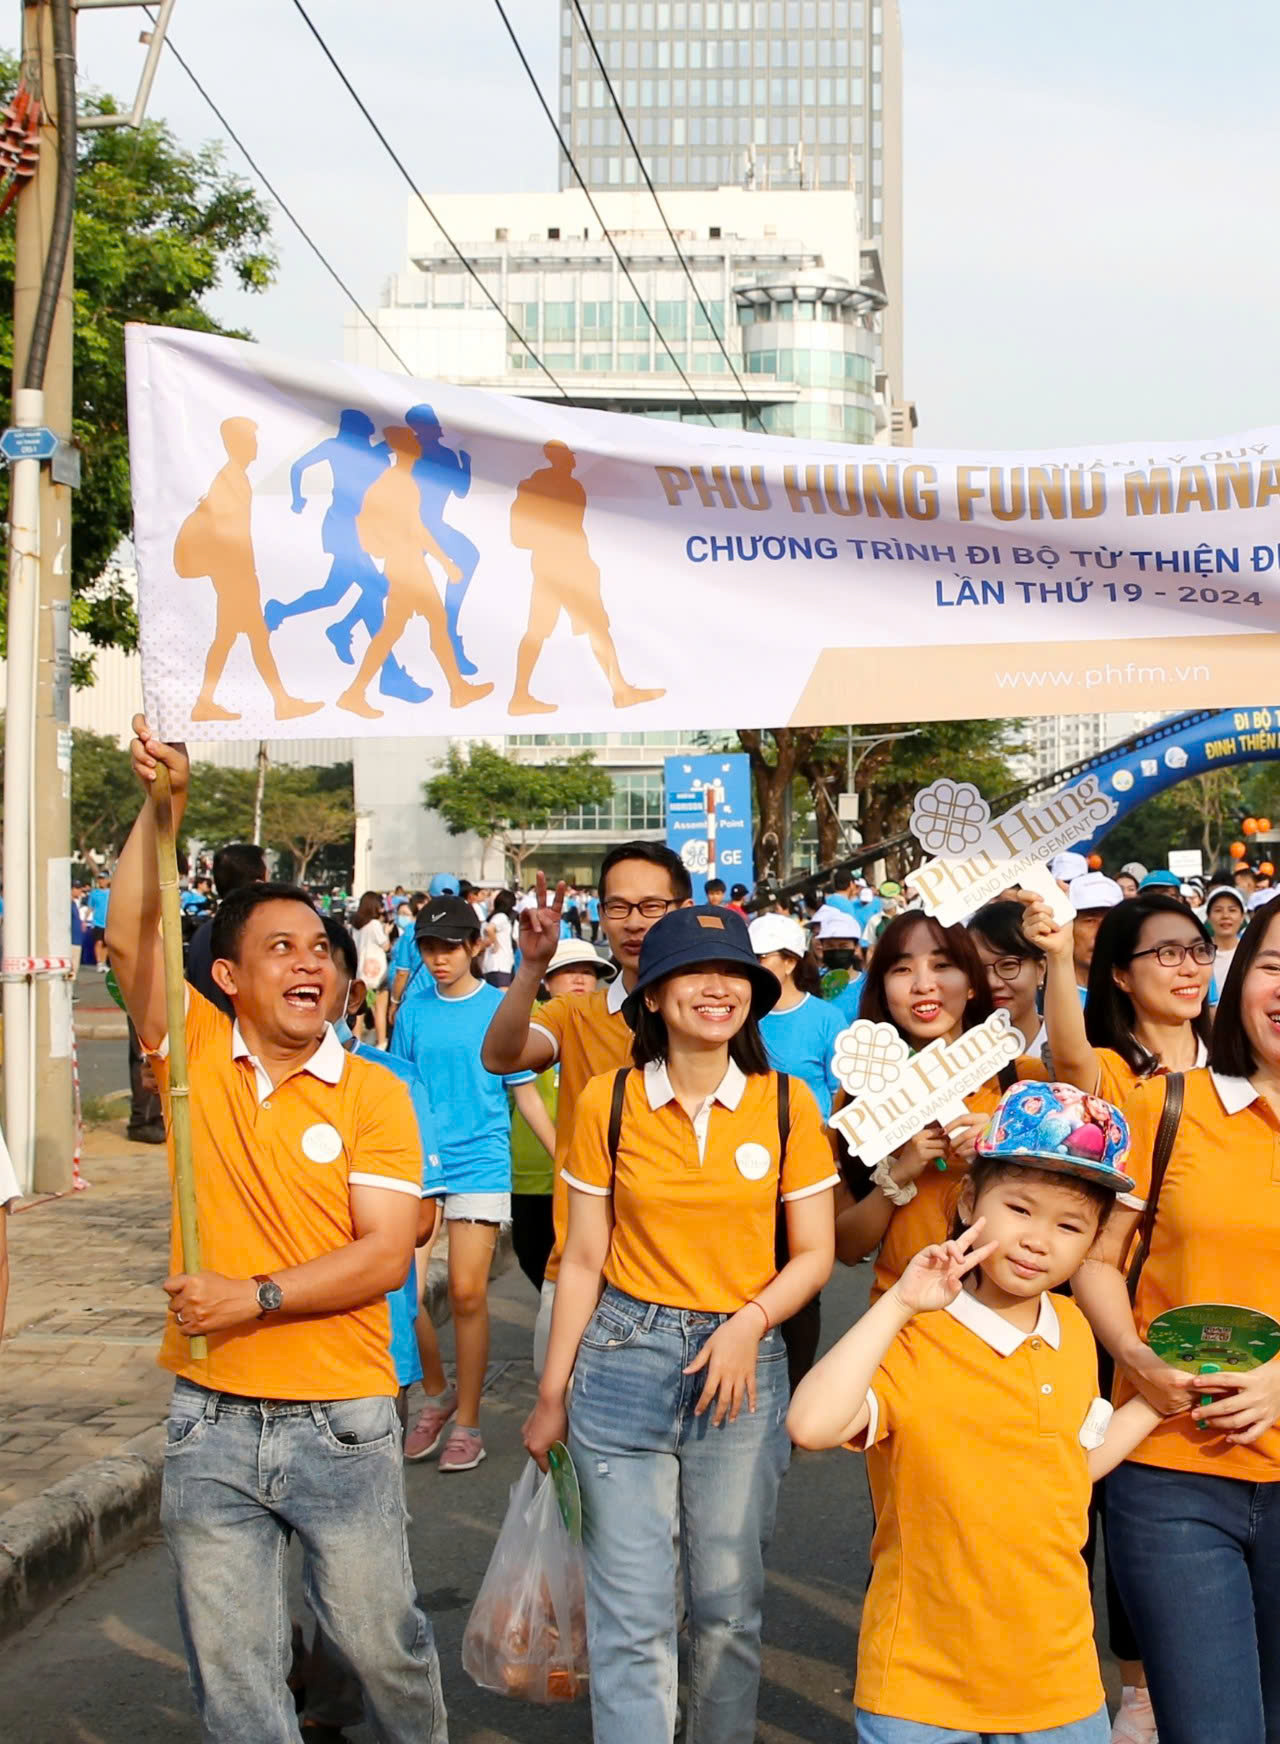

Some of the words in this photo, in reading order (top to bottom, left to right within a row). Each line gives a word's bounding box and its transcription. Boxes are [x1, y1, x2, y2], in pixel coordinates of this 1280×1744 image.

[655, 465, 774, 511] PHU
[783, 464, 940, 521] HUNG
[957, 463, 1107, 521] FUND
[686, 534, 838, 563] CHƯƠNG
[847, 539, 957, 563] TRÌNH
[966, 545, 1001, 565] ĐI
[1012, 544, 1060, 570] BỘ
[1070, 546, 1122, 570] TỪ
[1131, 543, 1240, 579] THIỆN
[936, 572, 1005, 607] LẦN
[1015, 576, 1093, 604] THỨ
[1103, 583, 1143, 602] 19
[1178, 585, 1264, 607] 2024
[994, 663, 1211, 689] www.phfm.vn
[1233, 712, 1250, 731] ĐI
[1252, 708, 1272, 730] BỘ
[1205, 738, 1237, 760] ĐINH
[1239, 730, 1277, 752] THIỆN
[720, 849, 743, 866] GE
[914, 849, 998, 909] Phu
[992, 777, 1110, 859] Hung
[963, 877, 1001, 906] FUND
[1002, 817, 1096, 883] MANAGEMENT
[838, 1088, 919, 1149] Phu
[911, 1013, 1021, 1095] Hung
[884, 1114, 921, 1145] FUND
[921, 1052, 1009, 1118] MANAGEMENT
